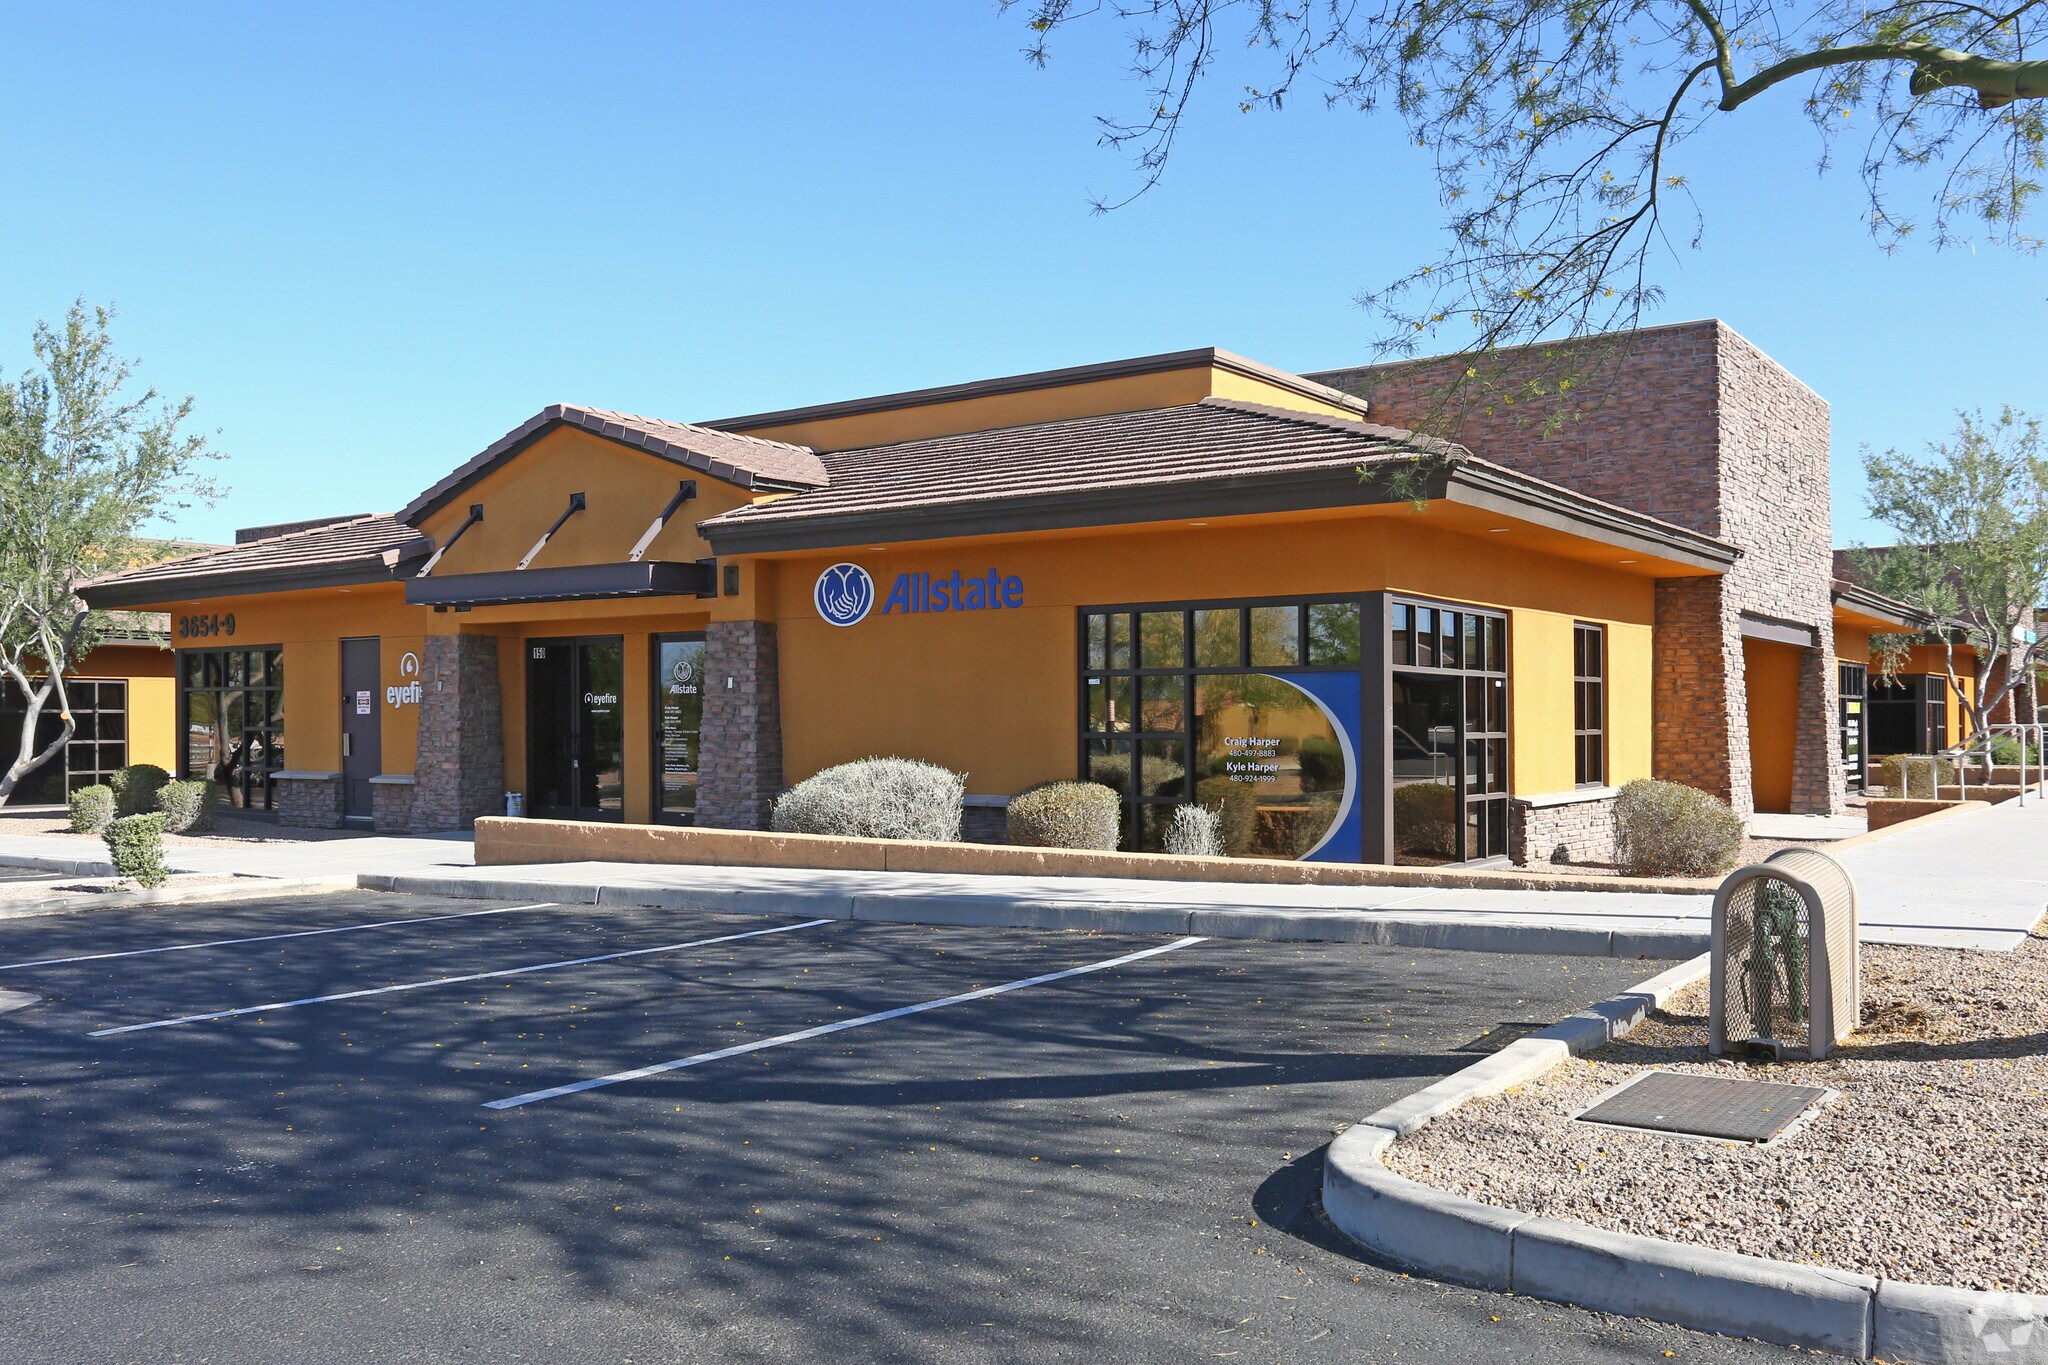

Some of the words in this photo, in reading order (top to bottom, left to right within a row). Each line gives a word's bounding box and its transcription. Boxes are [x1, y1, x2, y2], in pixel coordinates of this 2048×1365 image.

[882, 567, 1024, 614] Allstate
[179, 613, 236, 638] 3654-9
[533, 647, 546, 659] 150
[386, 680, 423, 709] eyefi
[669, 684, 698, 694] Allstate
[593, 692, 617, 706] eyefire
[1224, 736, 1248, 748] Craig
[1249, 736, 1280, 748] Harper
[1228, 749, 1276, 757] 480-497-8883
[1226, 761, 1246, 773] Kyle
[1247, 761, 1279, 774] Harper
[1229, 774, 1276, 783] 480-924-1999
